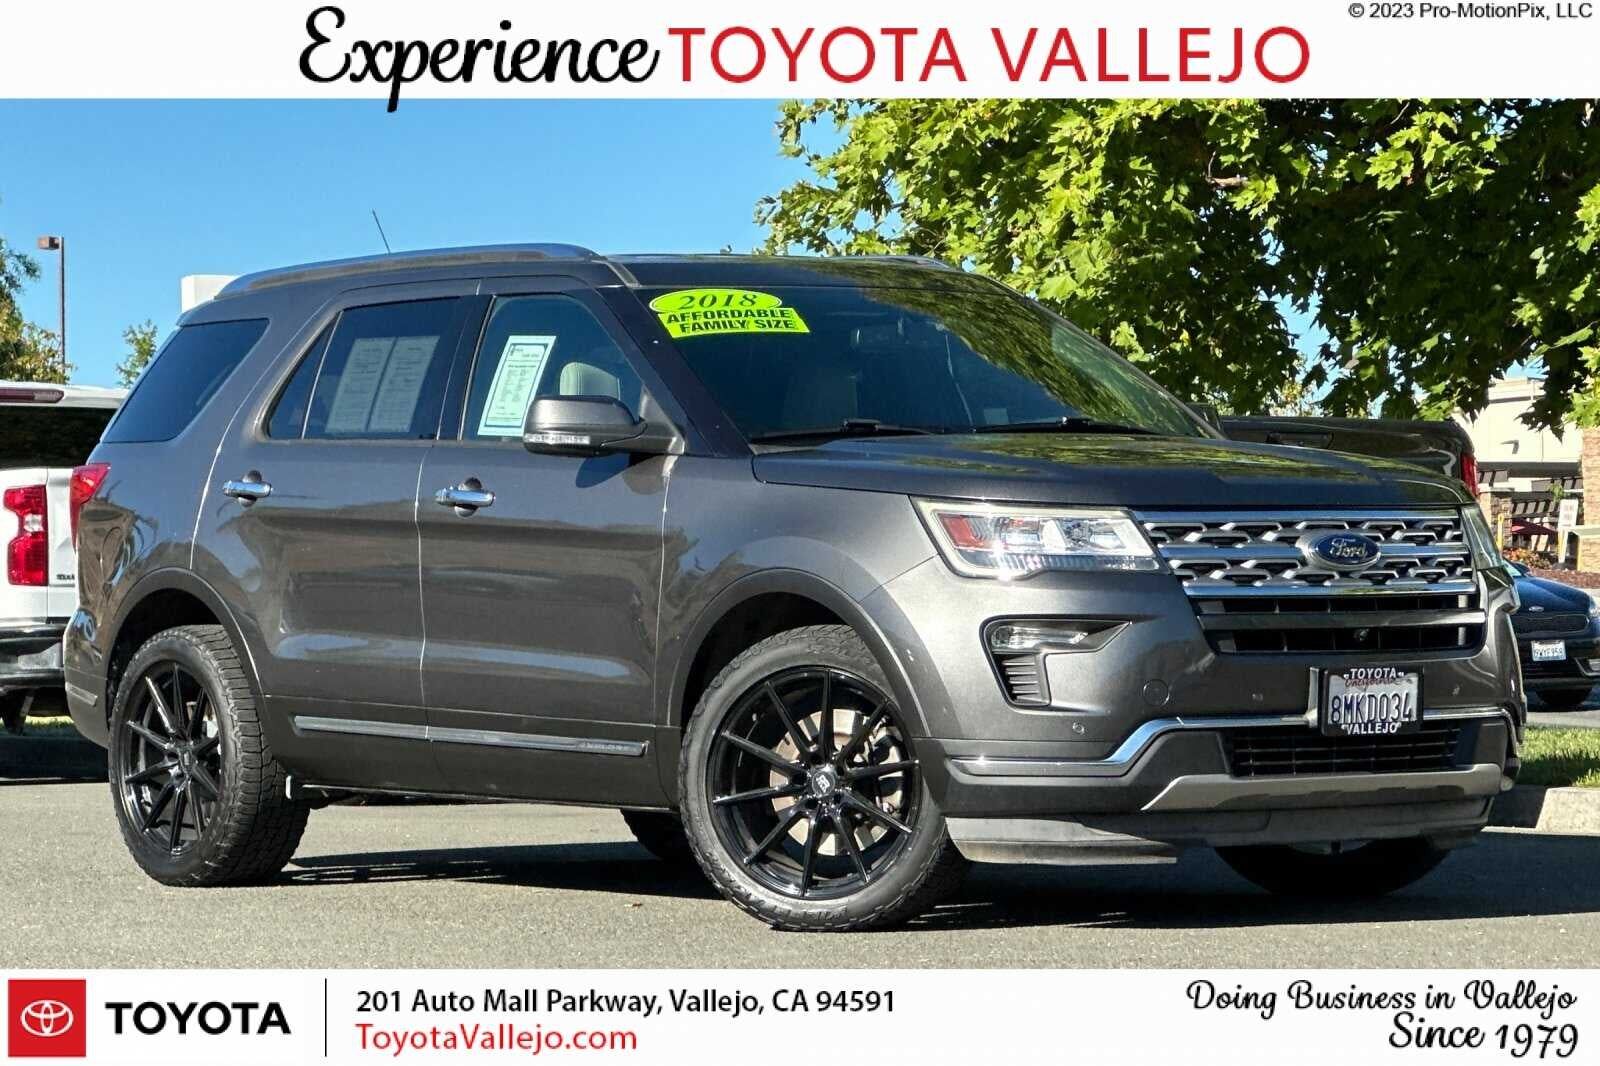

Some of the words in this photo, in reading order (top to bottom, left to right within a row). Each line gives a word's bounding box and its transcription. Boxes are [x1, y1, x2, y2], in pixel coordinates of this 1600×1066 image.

[678, 294, 757, 310] 2018
[667, 309, 792, 324] AFFORDABLE
[680, 319, 748, 333] FAMILY
[754, 319, 796, 330] SIZE
[1329, 537, 1368, 558] Ford
[1349, 667, 1397, 680] TOYOTA
[1331, 691, 1412, 724] 8MKD034
[1345, 722, 1399, 735] VALLEJO
